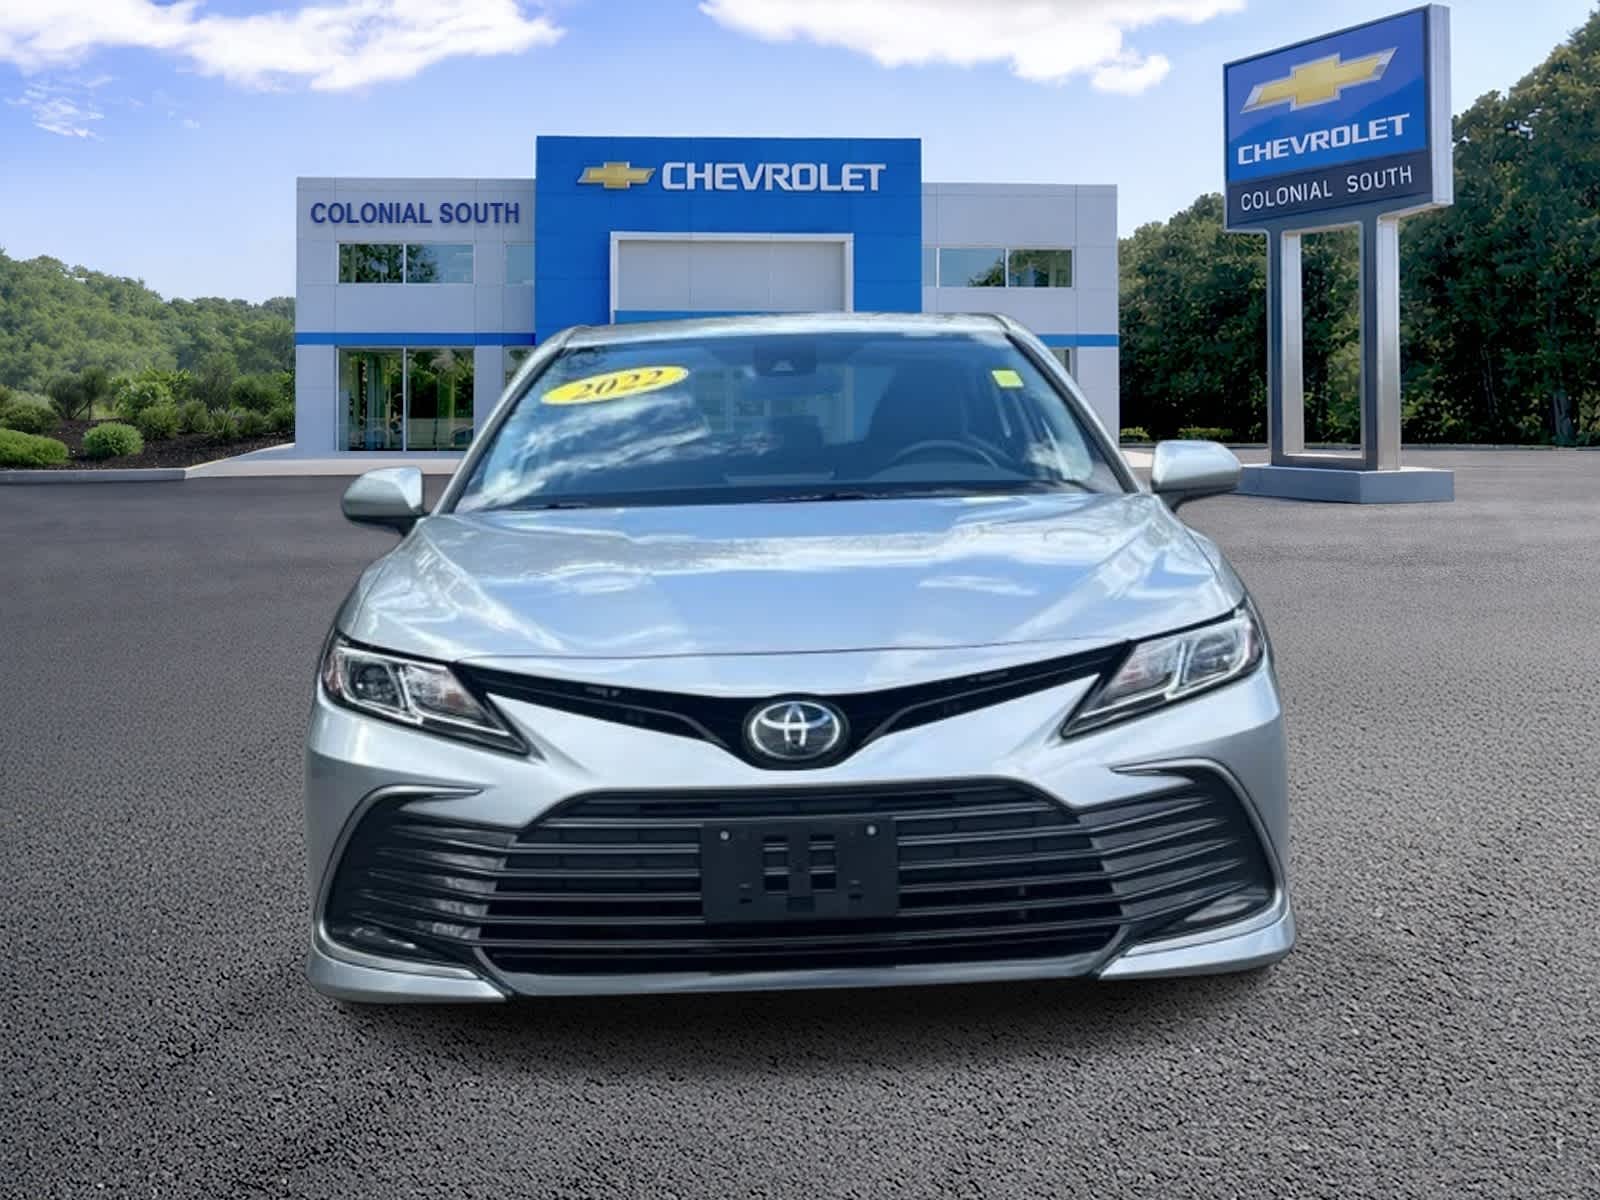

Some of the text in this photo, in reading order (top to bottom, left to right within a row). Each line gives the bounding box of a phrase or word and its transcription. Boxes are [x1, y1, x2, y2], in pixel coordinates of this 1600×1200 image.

[1238, 113, 1410, 166] CHEVROLET
[662, 161, 887, 193] CHEVROLET
[1240, 164, 1413, 212] COLONIAL SOUTH
[310, 202, 521, 225] COLONIAL SOUTH
[571, 369, 664, 401] 2022
